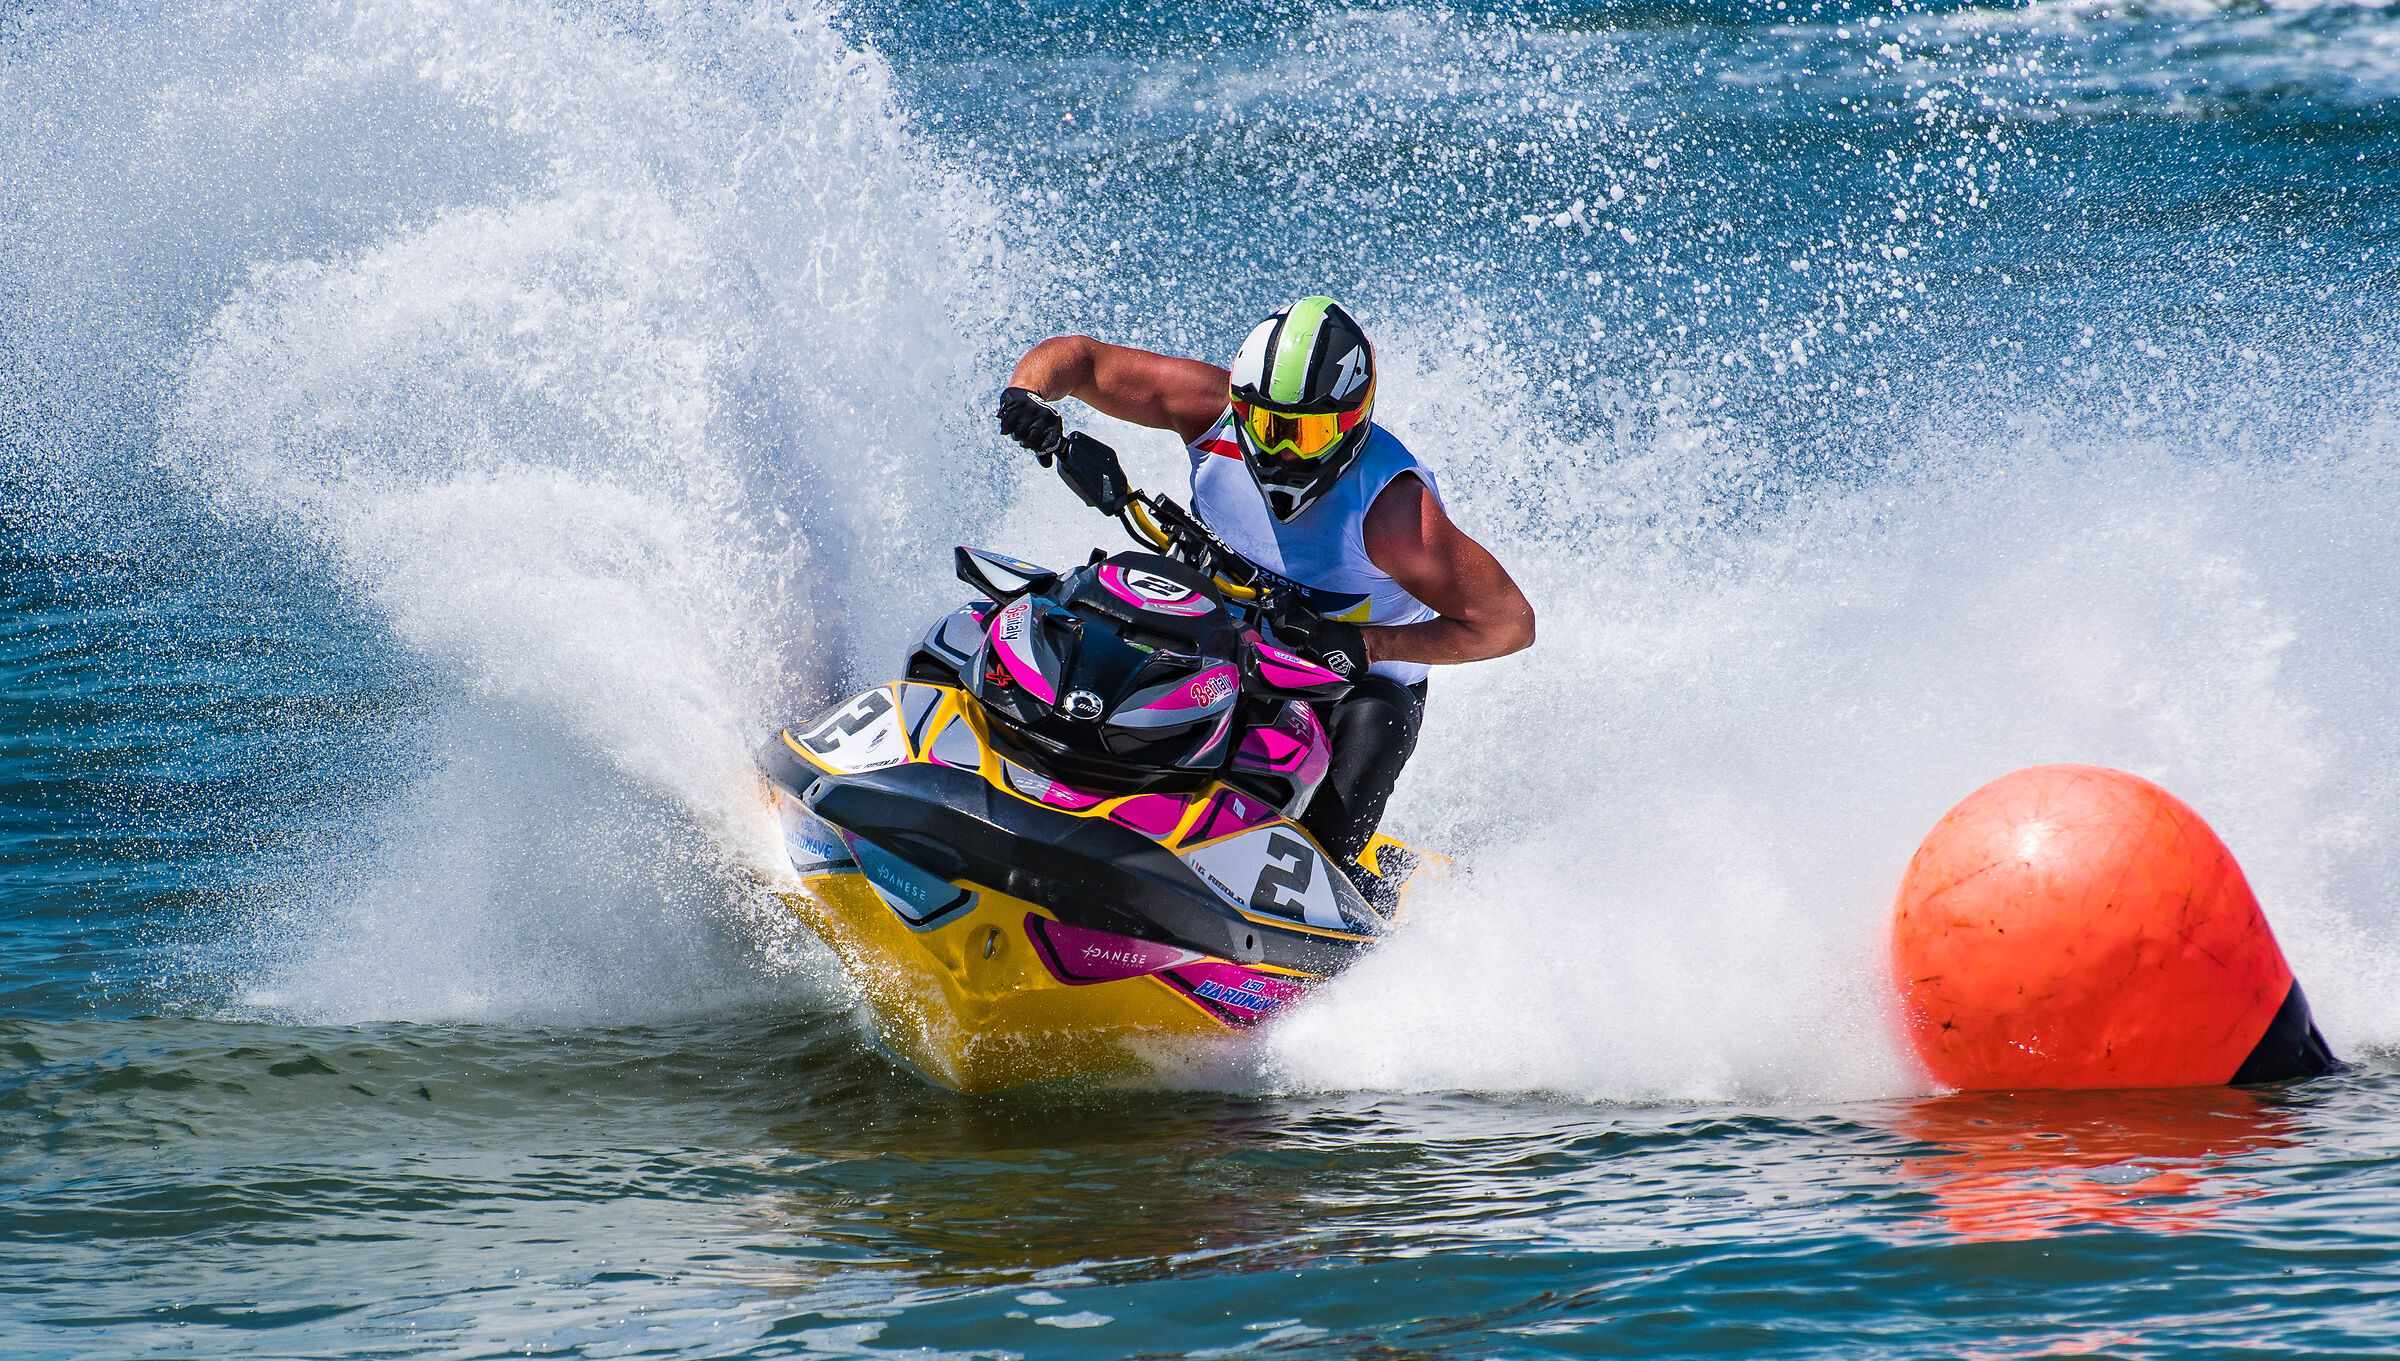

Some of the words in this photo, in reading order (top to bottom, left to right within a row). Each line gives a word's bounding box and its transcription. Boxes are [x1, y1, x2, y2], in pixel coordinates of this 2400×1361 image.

[1001, 604, 1029, 640] Betitaly
[1191, 673, 1235, 708] Betitaly
[800, 691, 893, 754] 2
[883, 869, 927, 901] DANESE
[1250, 832, 1315, 924] 2
[1090, 948, 1147, 965] DANESE
[1240, 979, 1266, 992] ASD
